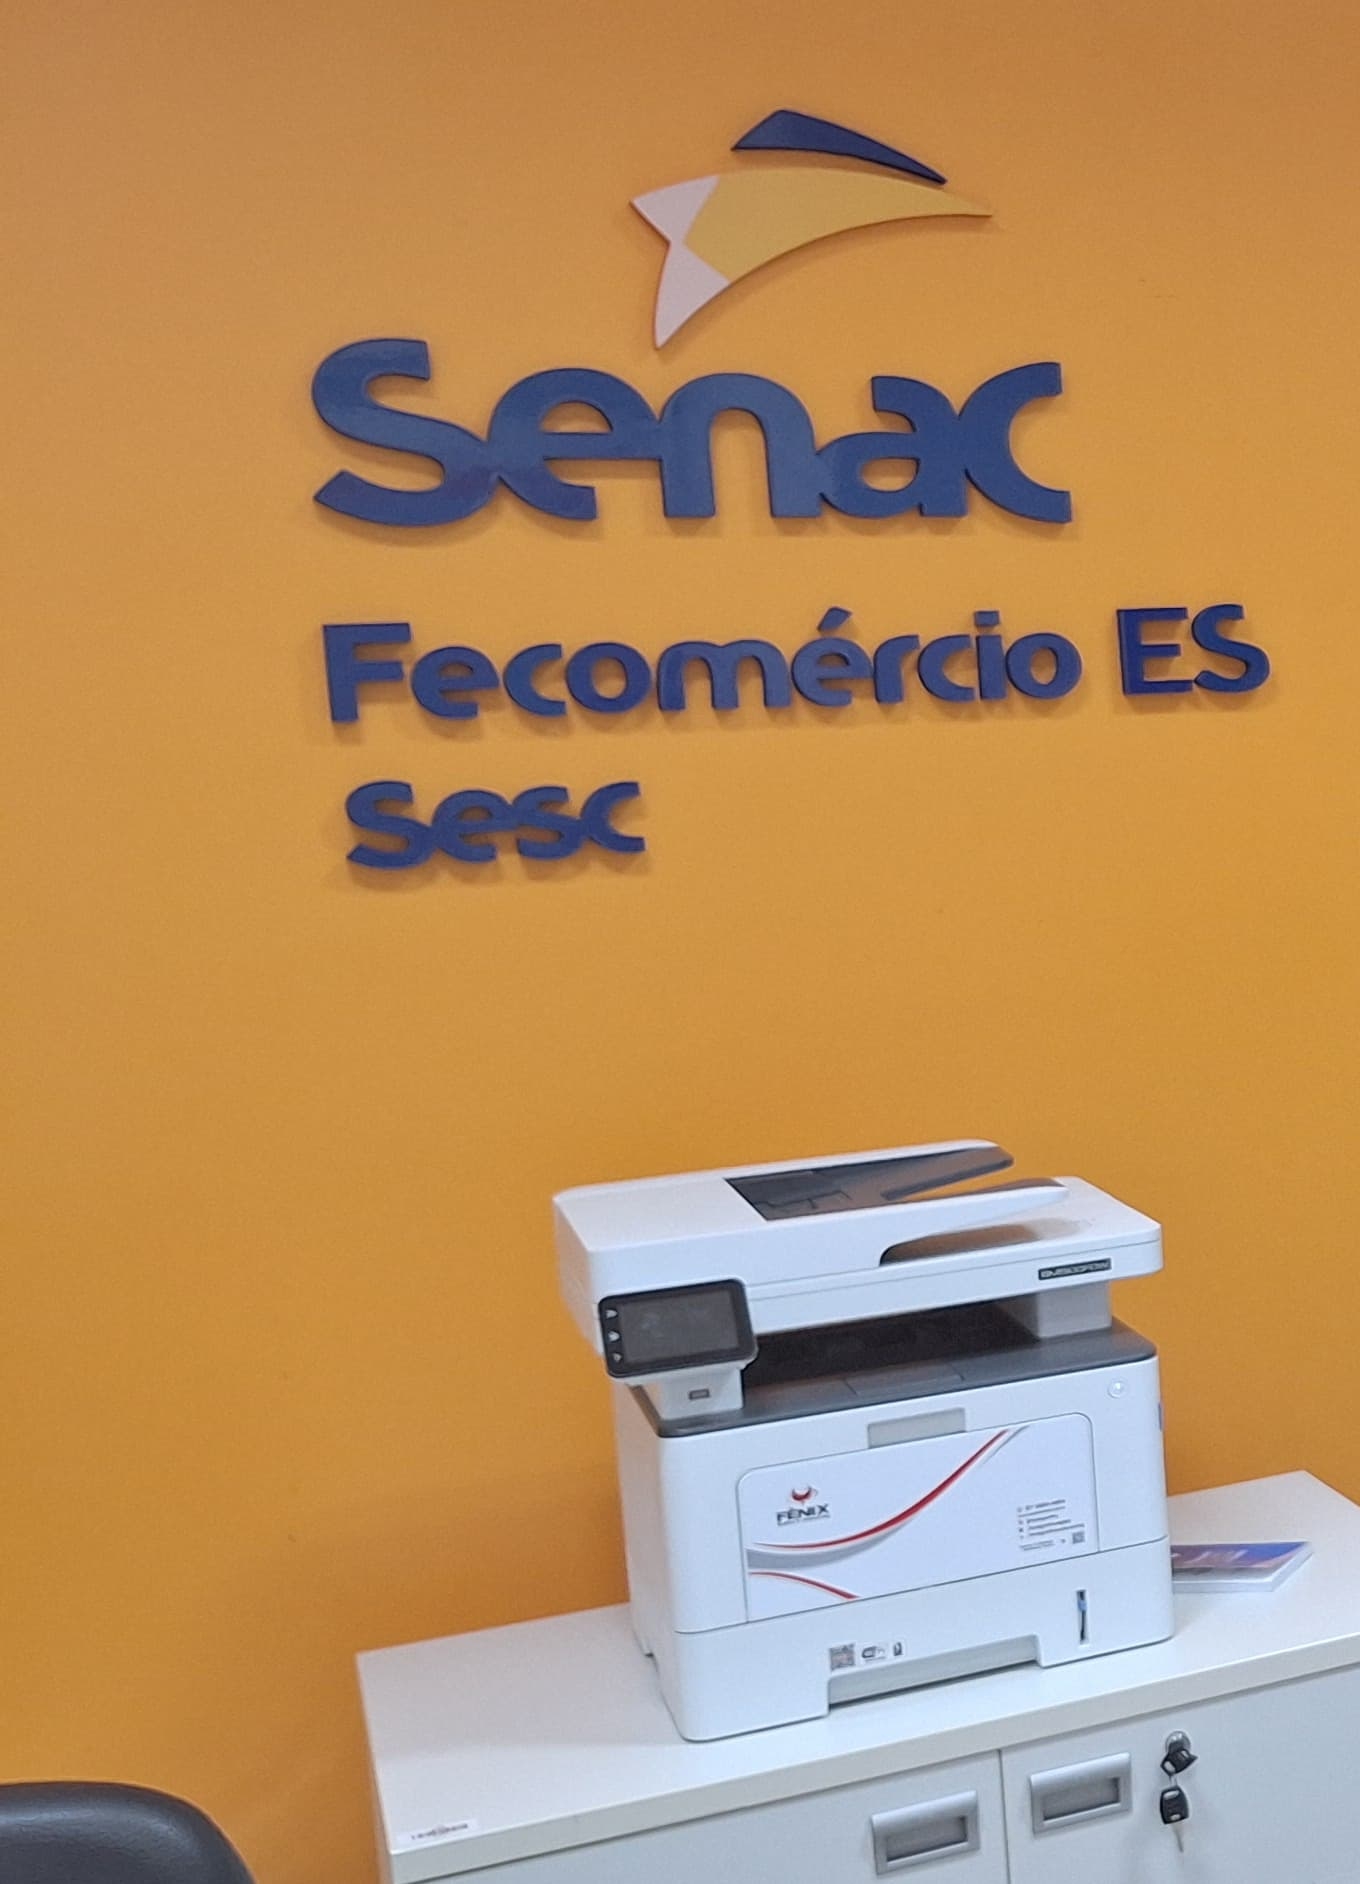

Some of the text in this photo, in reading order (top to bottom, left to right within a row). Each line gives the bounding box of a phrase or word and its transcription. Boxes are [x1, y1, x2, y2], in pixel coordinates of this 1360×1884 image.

[312, 338, 1072, 527] Senac
[323, 603, 1270, 723] Fecomércio ES
[345, 780, 645, 869] Sesc
